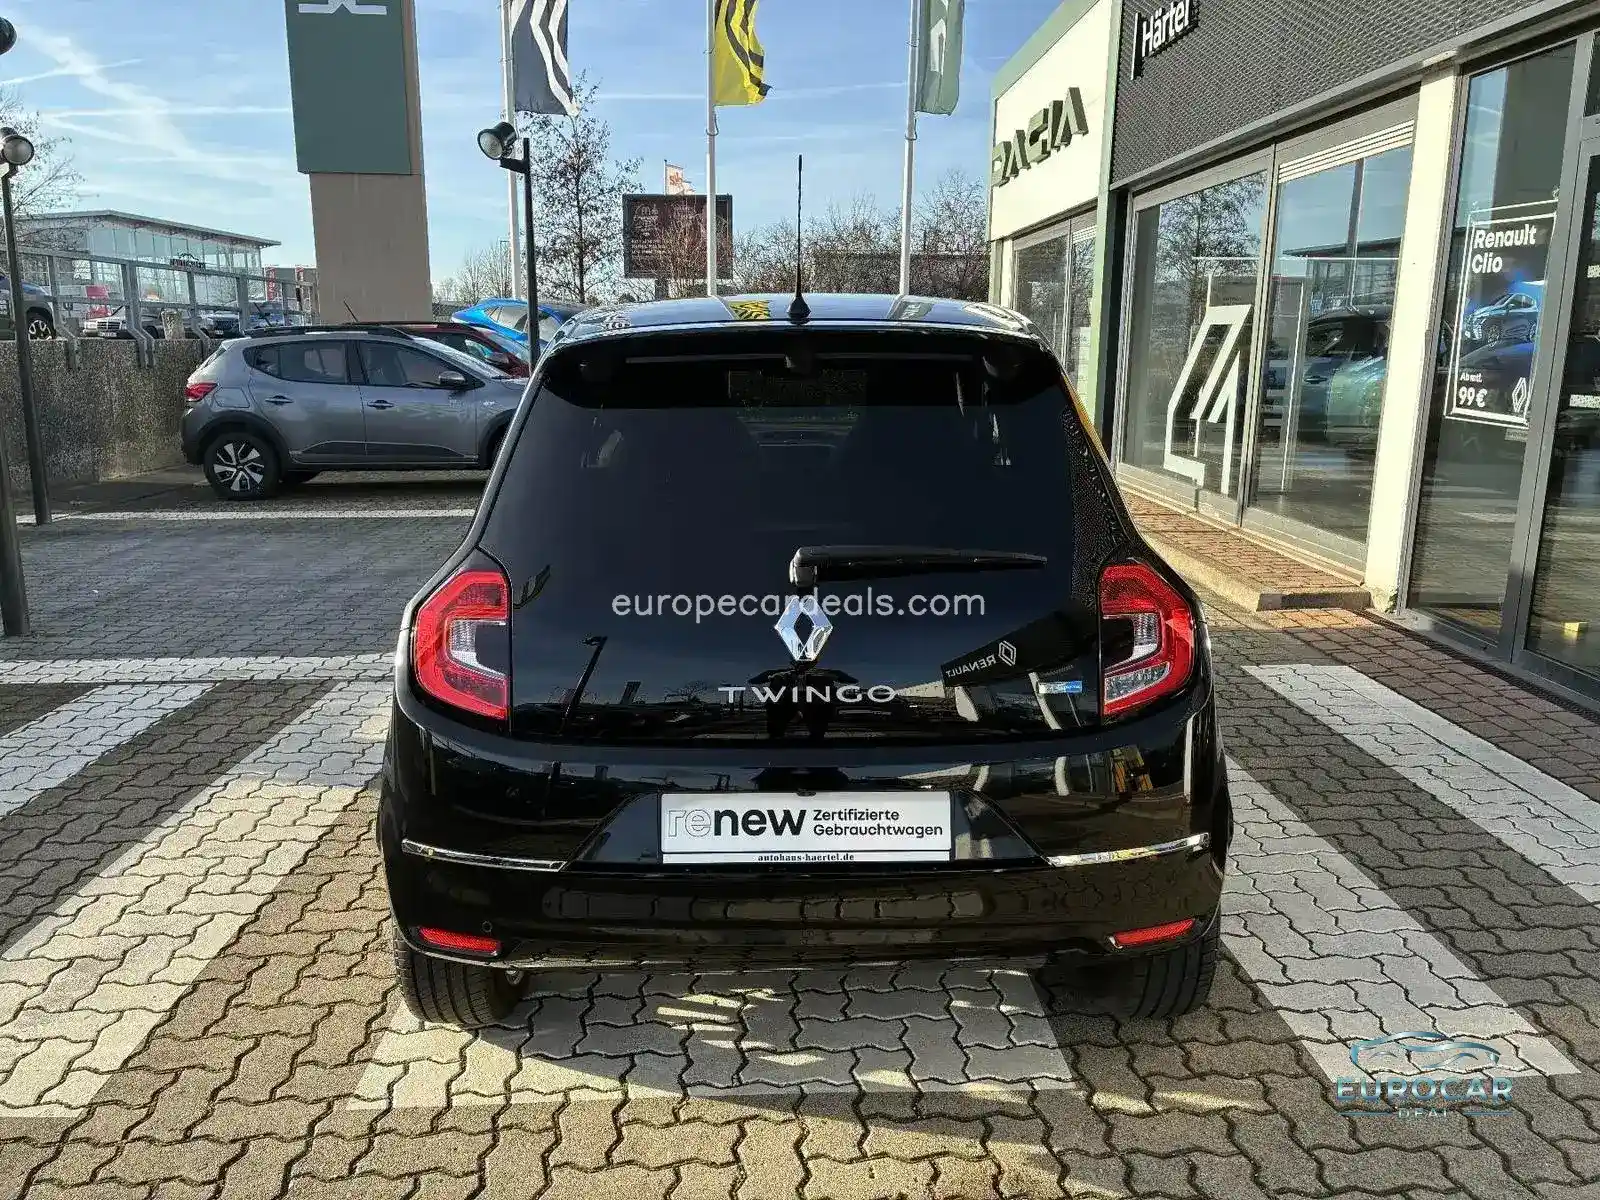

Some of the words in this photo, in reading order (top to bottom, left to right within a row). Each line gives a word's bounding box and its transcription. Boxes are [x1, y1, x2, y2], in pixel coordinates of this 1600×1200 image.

[1142, 0, 1190, 57] Härtel
[991, 87, 1089, 187] DACIA
[1473, 223, 1537, 249] Renault
[1471, 252, 1503, 274] Clio
[717, 685, 897, 703] TWINGO
[667, 809, 807, 838] renew
[812, 808, 900, 821] Zertifizierte
[812, 823, 943, 839] Gebrauchtwagen
[757, 853, 855, 862] autohaus-haertel.de
